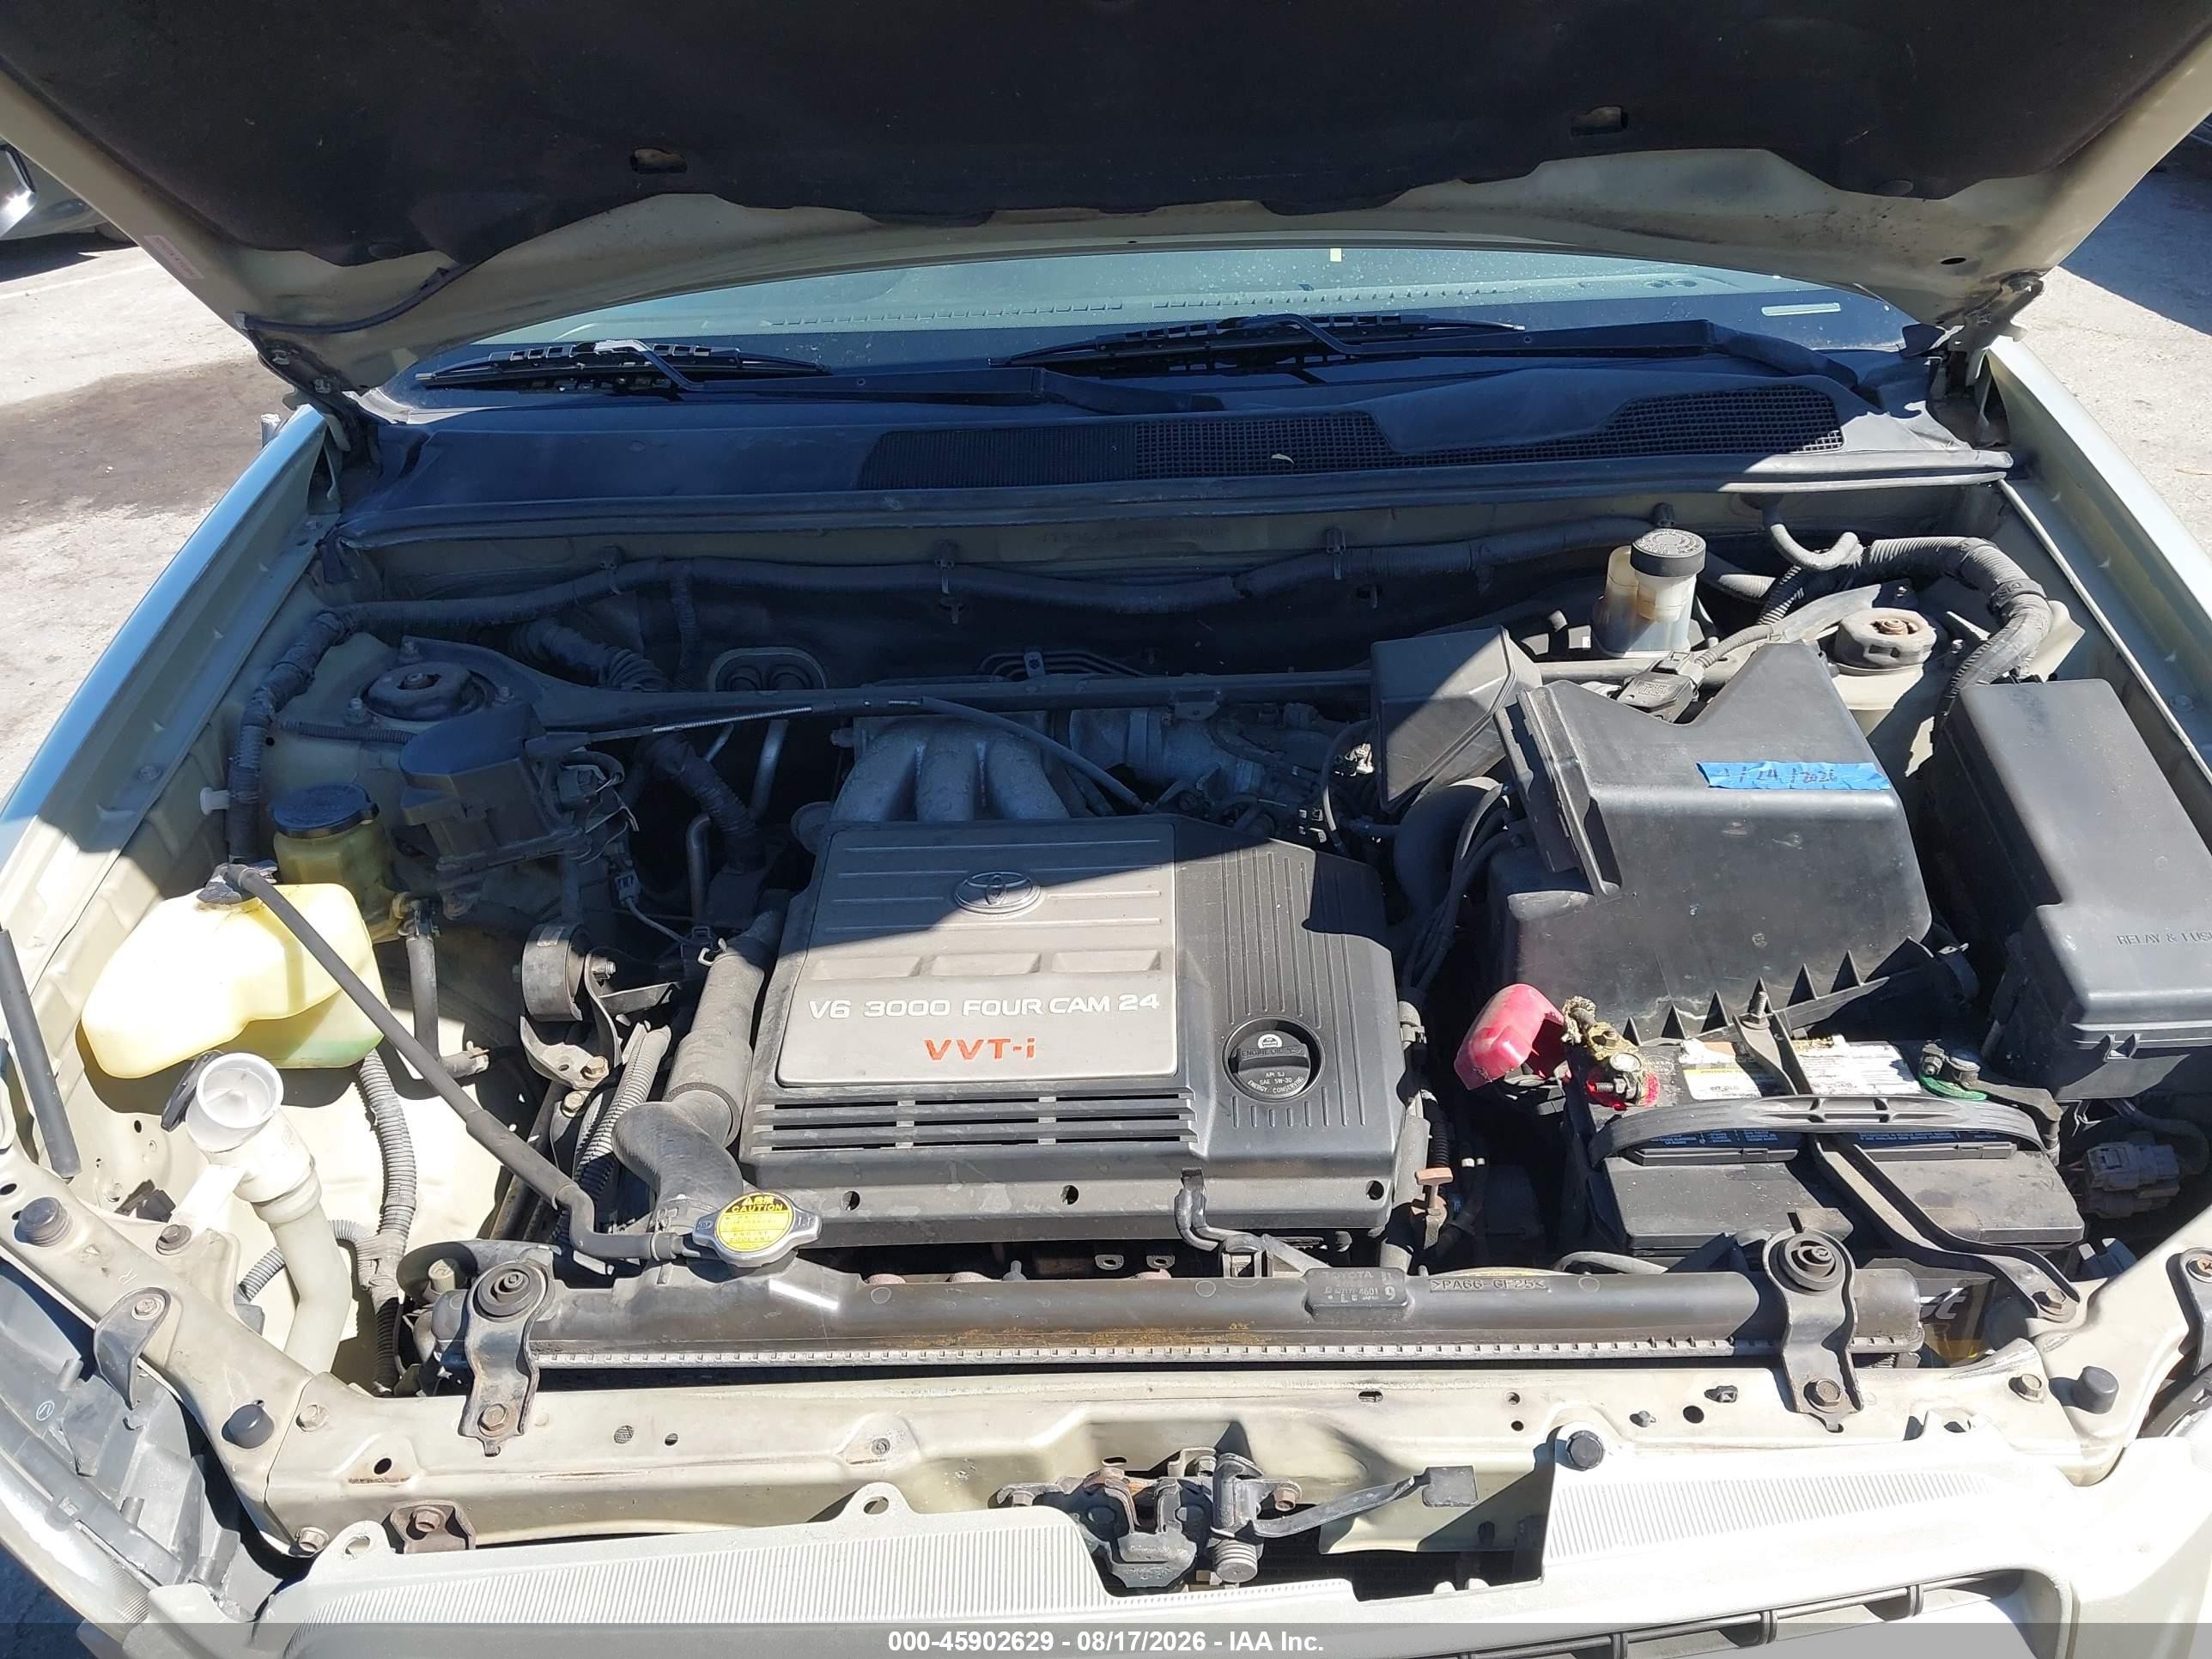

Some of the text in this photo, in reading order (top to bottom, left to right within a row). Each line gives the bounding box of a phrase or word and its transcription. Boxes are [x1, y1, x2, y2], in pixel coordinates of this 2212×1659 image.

[2116, 933, 2160, 945] RELAY
[2166, 933, 2178, 943] &
[809, 993, 1160, 1019] V6 3000 FOUR CAM 24
[923, 1036, 1036, 1061] VVT-i
[1242, 1048, 1285, 1057] ENGINE OIL
[1247, 1076, 1306, 1094] ENERGY CONSERVING
[732, 1204, 783, 1213] CAUTION
